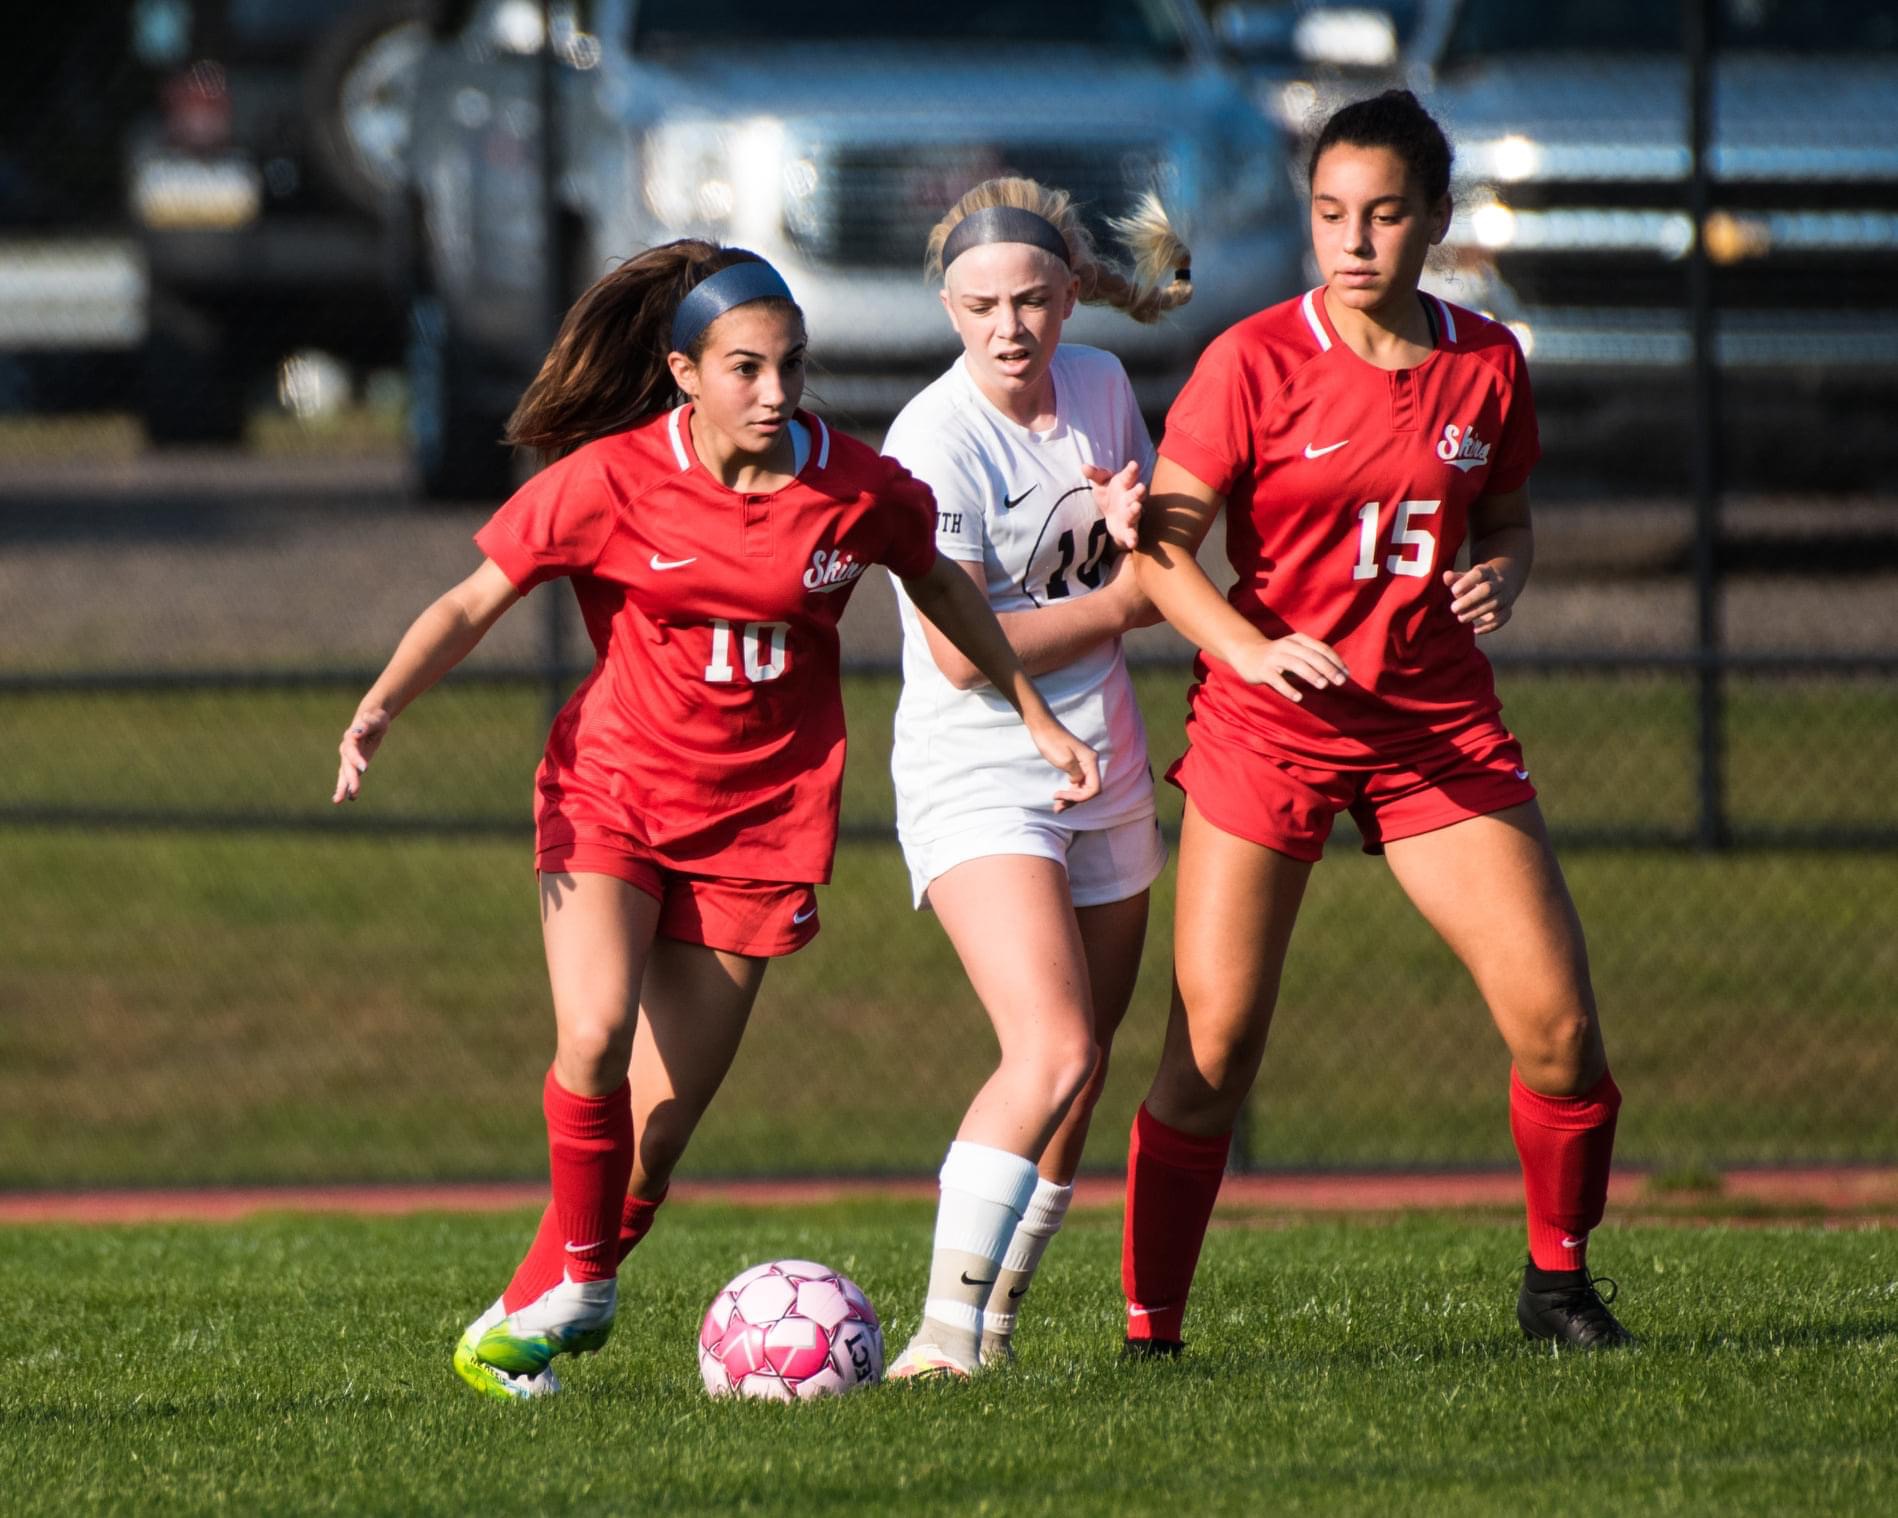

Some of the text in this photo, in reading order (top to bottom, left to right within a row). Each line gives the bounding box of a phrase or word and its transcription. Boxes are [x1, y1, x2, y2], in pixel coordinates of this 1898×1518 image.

[1046, 517, 1109, 600] 10
[1353, 500, 1441, 580] 15
[704, 618, 791, 683] 10
[844, 1331, 874, 1383] ECT
